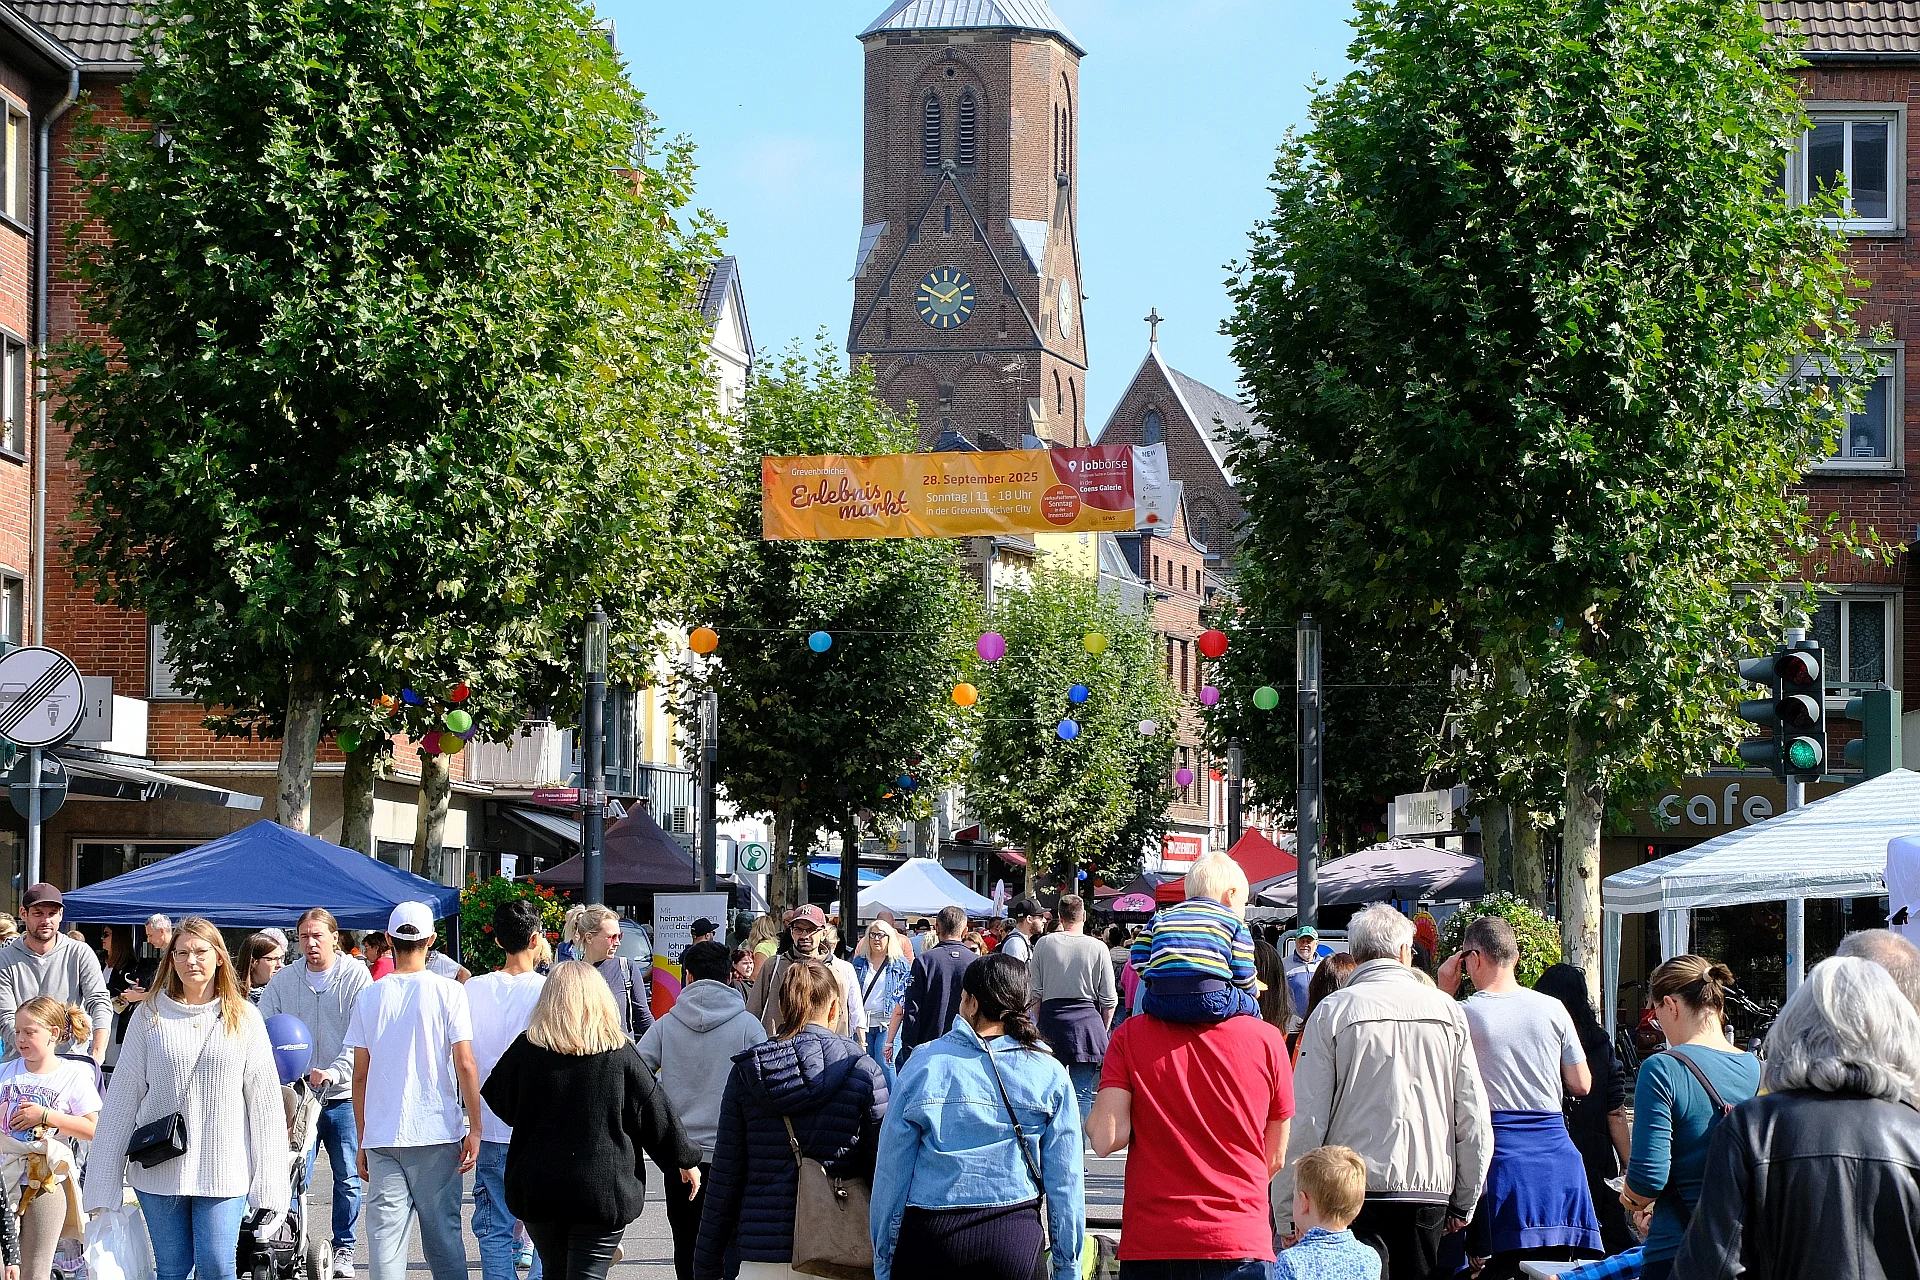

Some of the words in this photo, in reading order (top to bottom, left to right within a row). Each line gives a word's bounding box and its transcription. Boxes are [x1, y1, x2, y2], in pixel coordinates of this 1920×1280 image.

[791, 467, 848, 476] Grevenbroicher
[1080, 458, 1128, 473] Jobbörse
[923, 475, 941, 486] 28.
[943, 473, 1006, 487] September
[1008, 472, 1038, 483] 2025
[790, 476, 882, 510] Erlebnis
[1080, 485, 1098, 493] Coens
[1099, 484, 1122, 492] Galerie
[926, 491, 968, 504] Sonntag
[975, 491, 989, 502] 11
[998, 490, 1012, 501] 18
[1014, 489, 1033, 500] Uhr
[839, 490, 911, 520] markt
[926, 506, 934, 515] in
[935, 506, 949, 515] der
[951, 504, 1013, 515] Grevenbroicher
[1015, 504, 1032, 514] City
[1658, 783, 1773, 826] cafe
[660, 914, 686, 922] heimat
[687, 914, 718, 922] shoen
